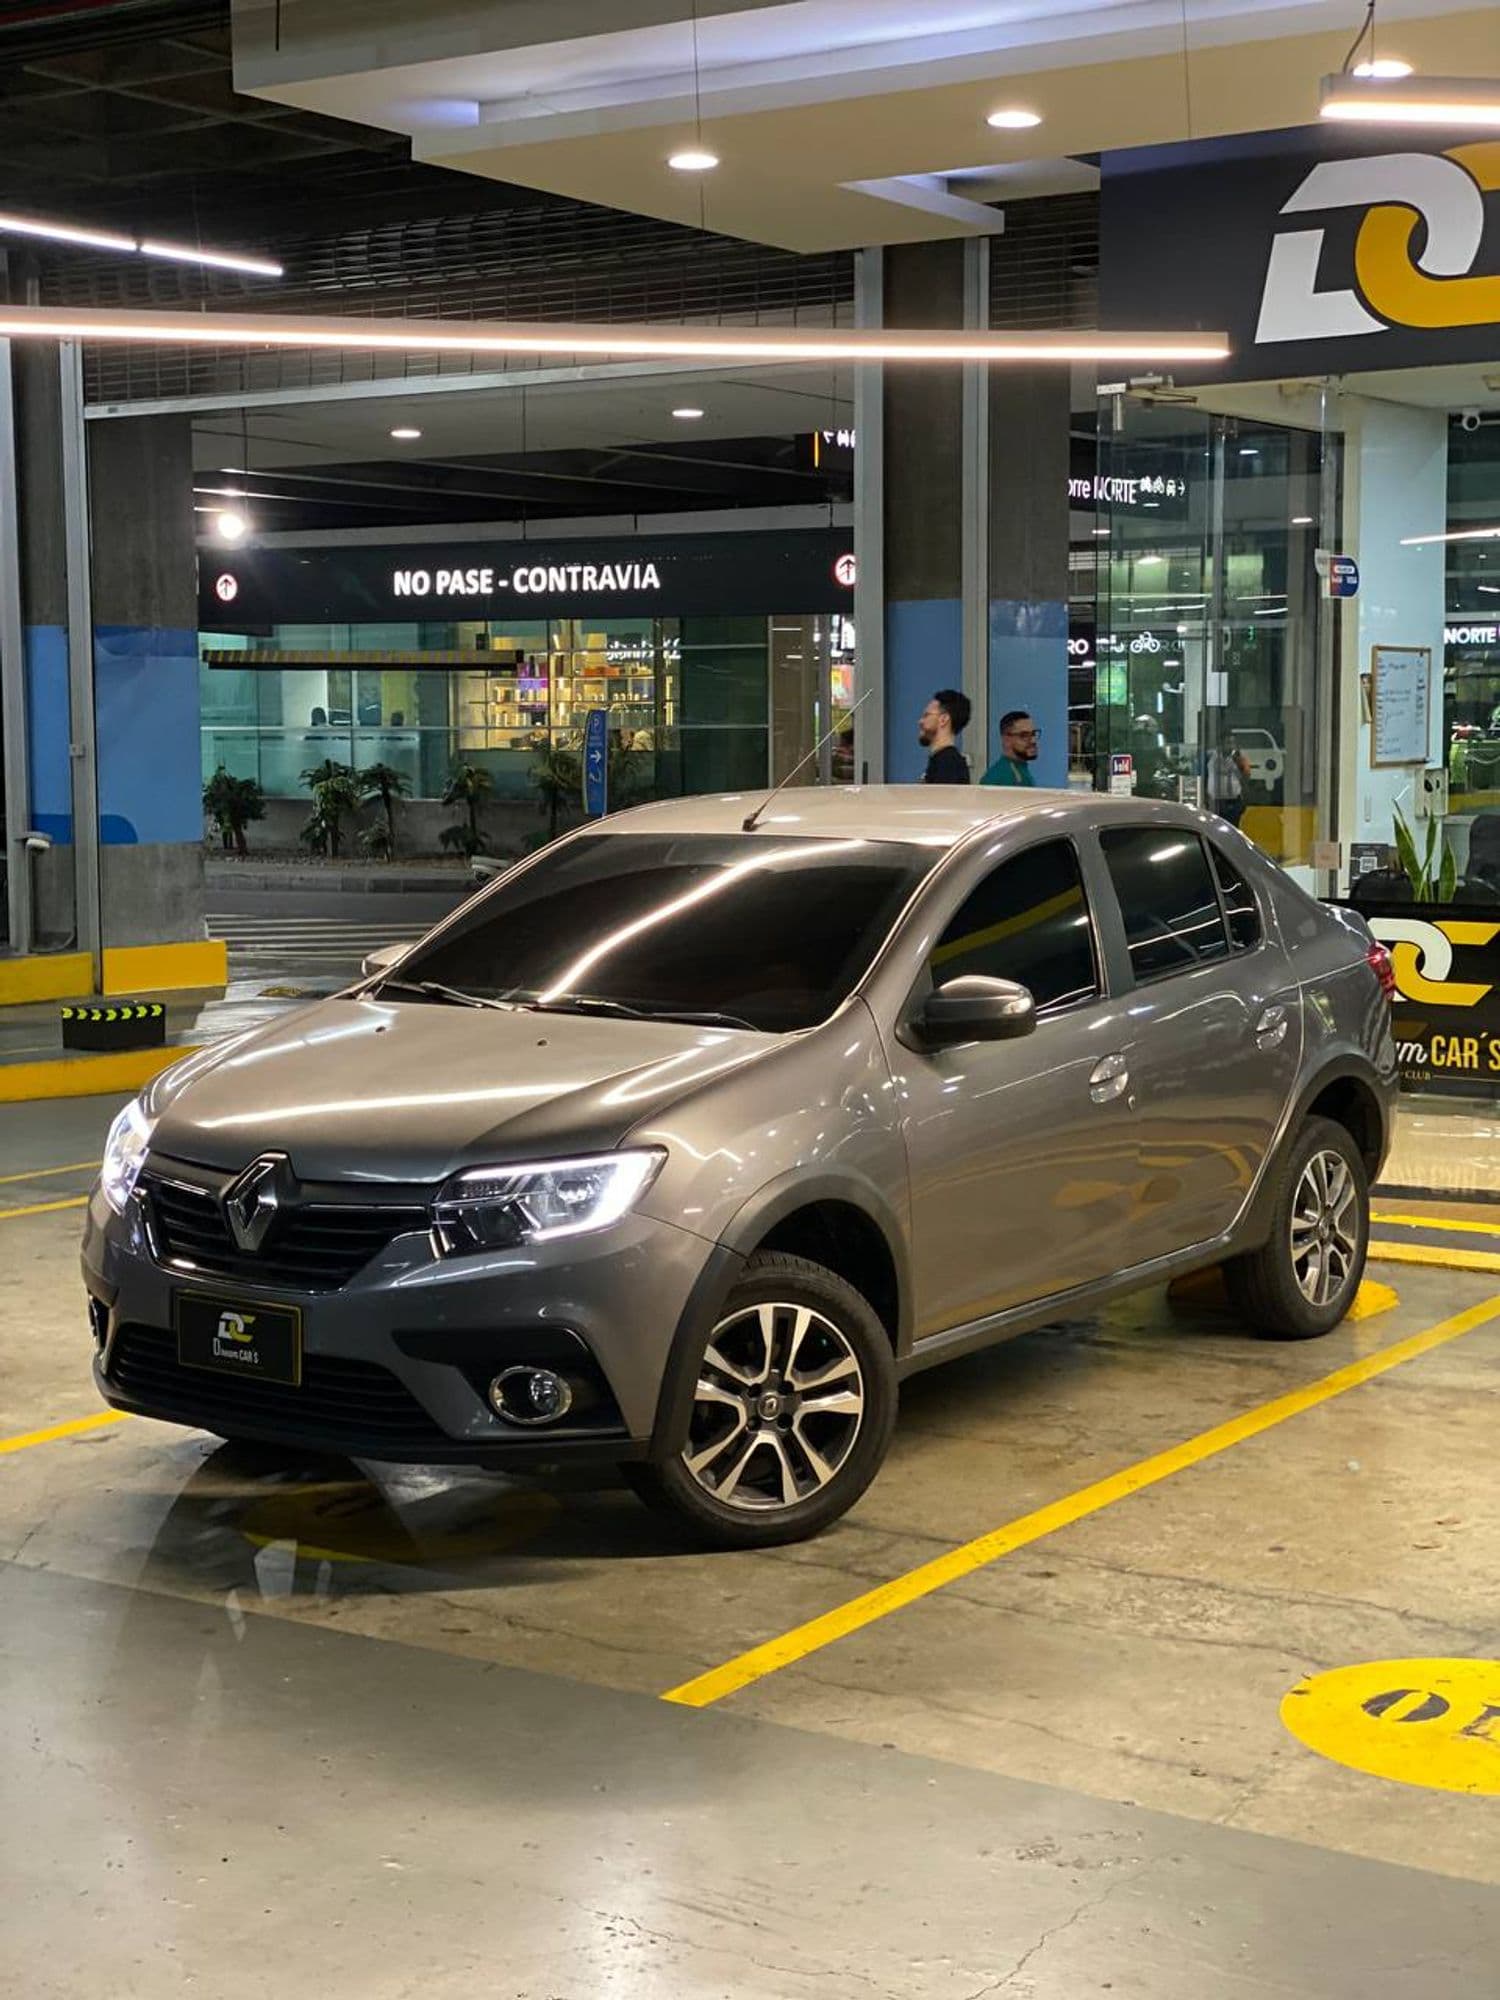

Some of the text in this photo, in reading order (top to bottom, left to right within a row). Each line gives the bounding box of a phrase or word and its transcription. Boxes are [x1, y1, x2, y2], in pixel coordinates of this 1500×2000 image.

[393, 570, 431, 596] NO
[435, 568, 494, 595] PASE
[512, 563, 661, 593] CONTRAVIA
[1443, 626, 1497, 644] NORTE
